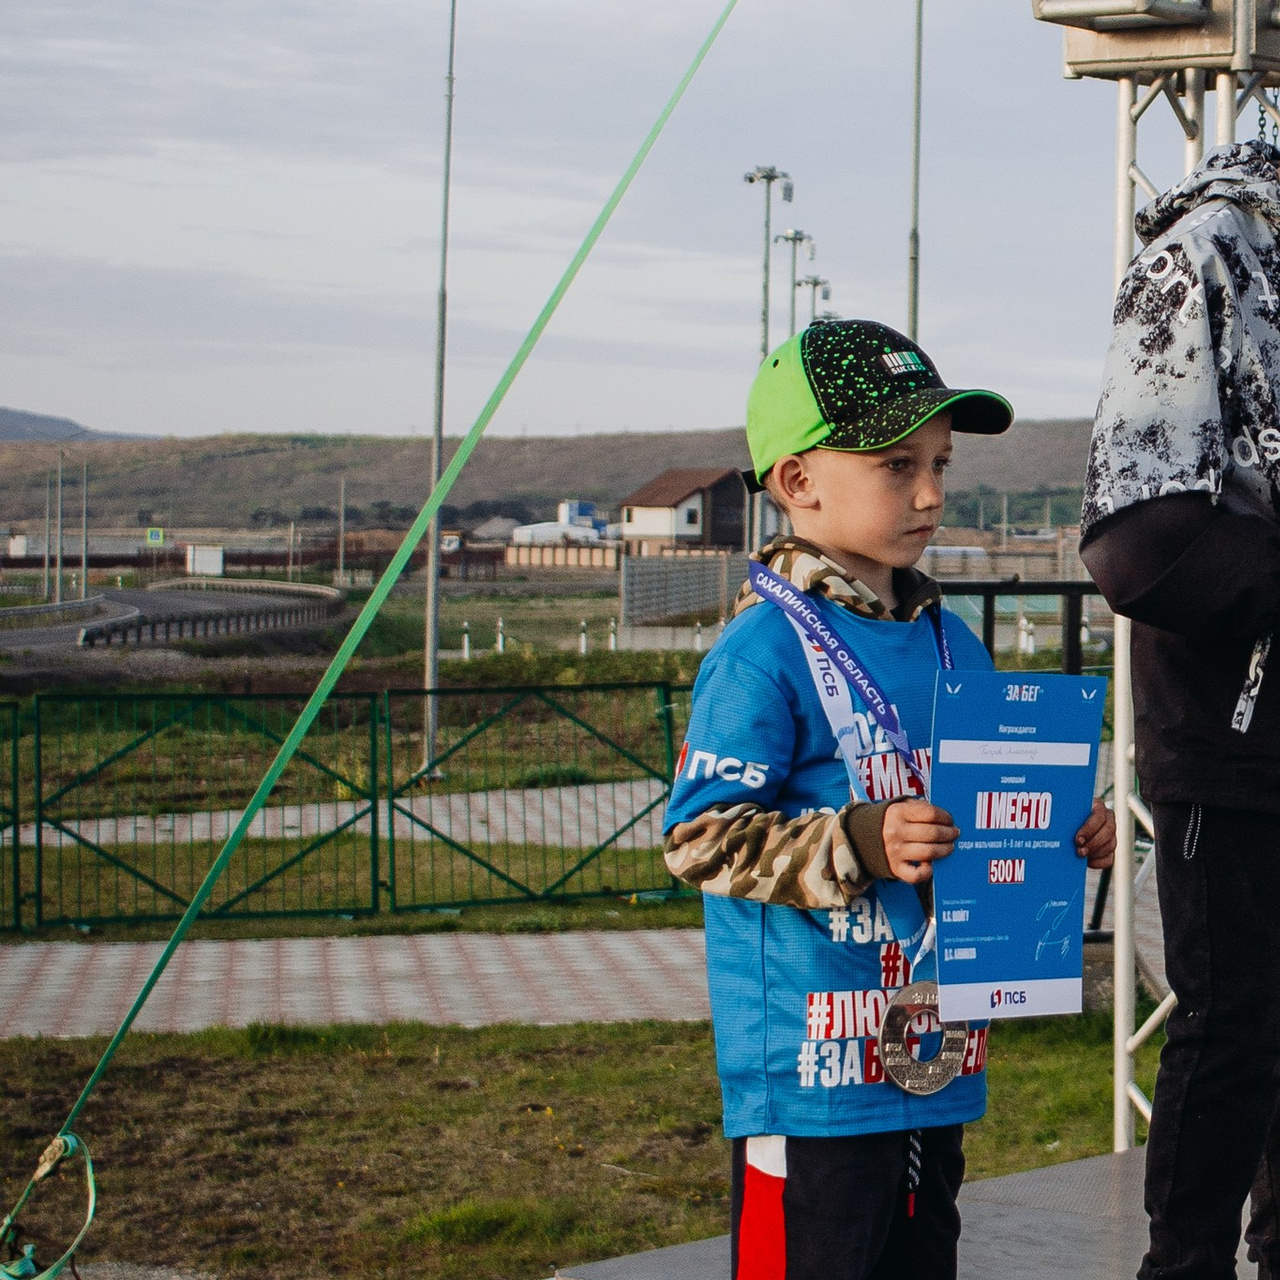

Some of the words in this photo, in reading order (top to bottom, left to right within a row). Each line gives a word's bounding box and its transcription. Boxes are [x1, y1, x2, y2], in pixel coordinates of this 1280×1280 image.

[756, 572, 839, 650] САХАЛИНСКАЯ
[836, 650, 886, 716] ОБЛАСТЬ
[816, 657, 840, 698] ПСБ
[687, 750, 770, 789] ПСБ
[988, 791, 1053, 830] МЕСТО
[989, 859, 1013, 882] 500
[1004, 991, 1027, 1004] ПСБ
